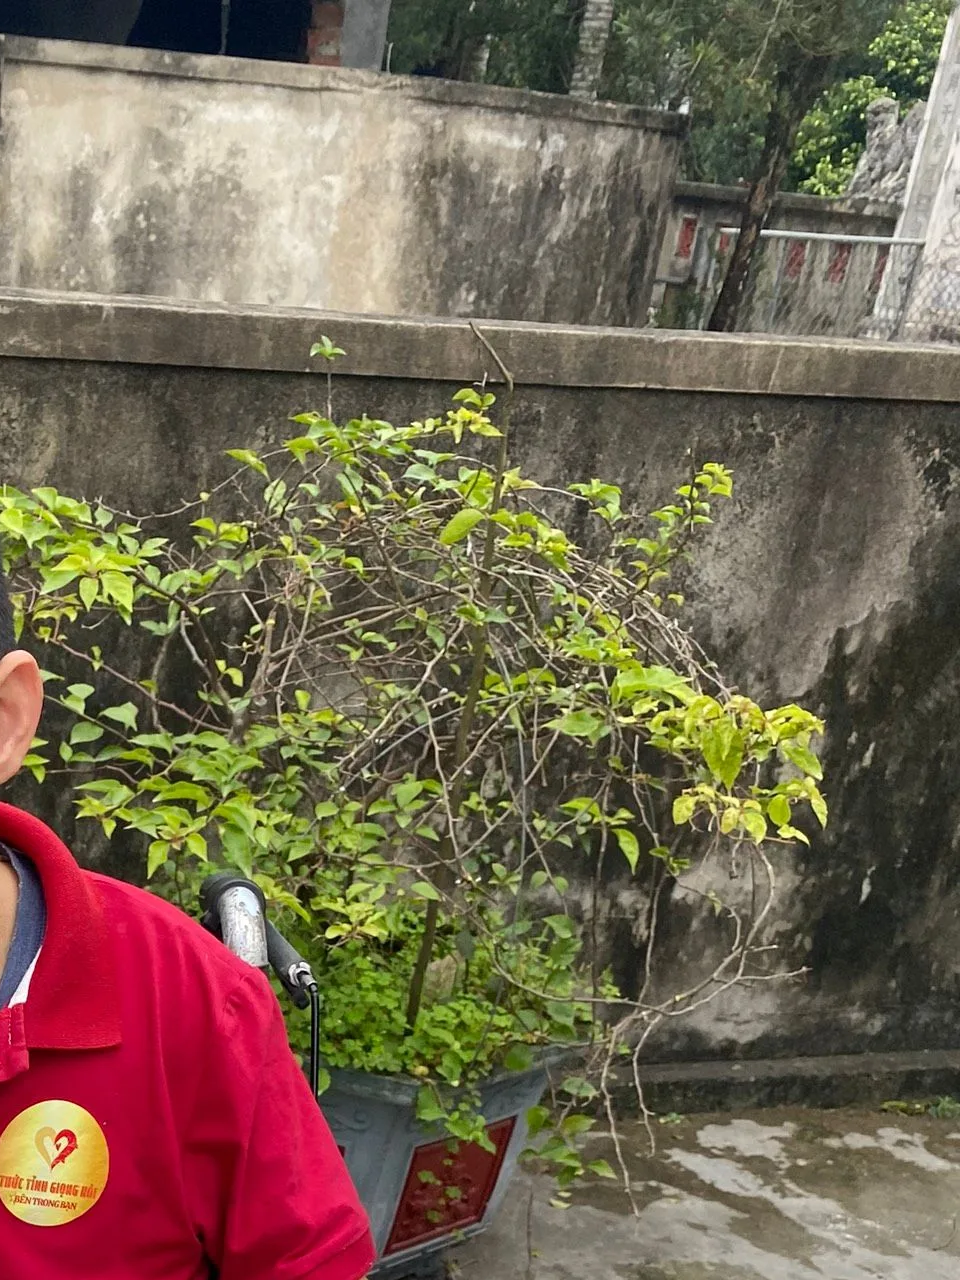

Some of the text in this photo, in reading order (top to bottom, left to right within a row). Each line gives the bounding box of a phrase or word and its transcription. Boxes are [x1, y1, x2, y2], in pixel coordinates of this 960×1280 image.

[15, 1194, 77, 1211] BÊN TRONG BẠN
